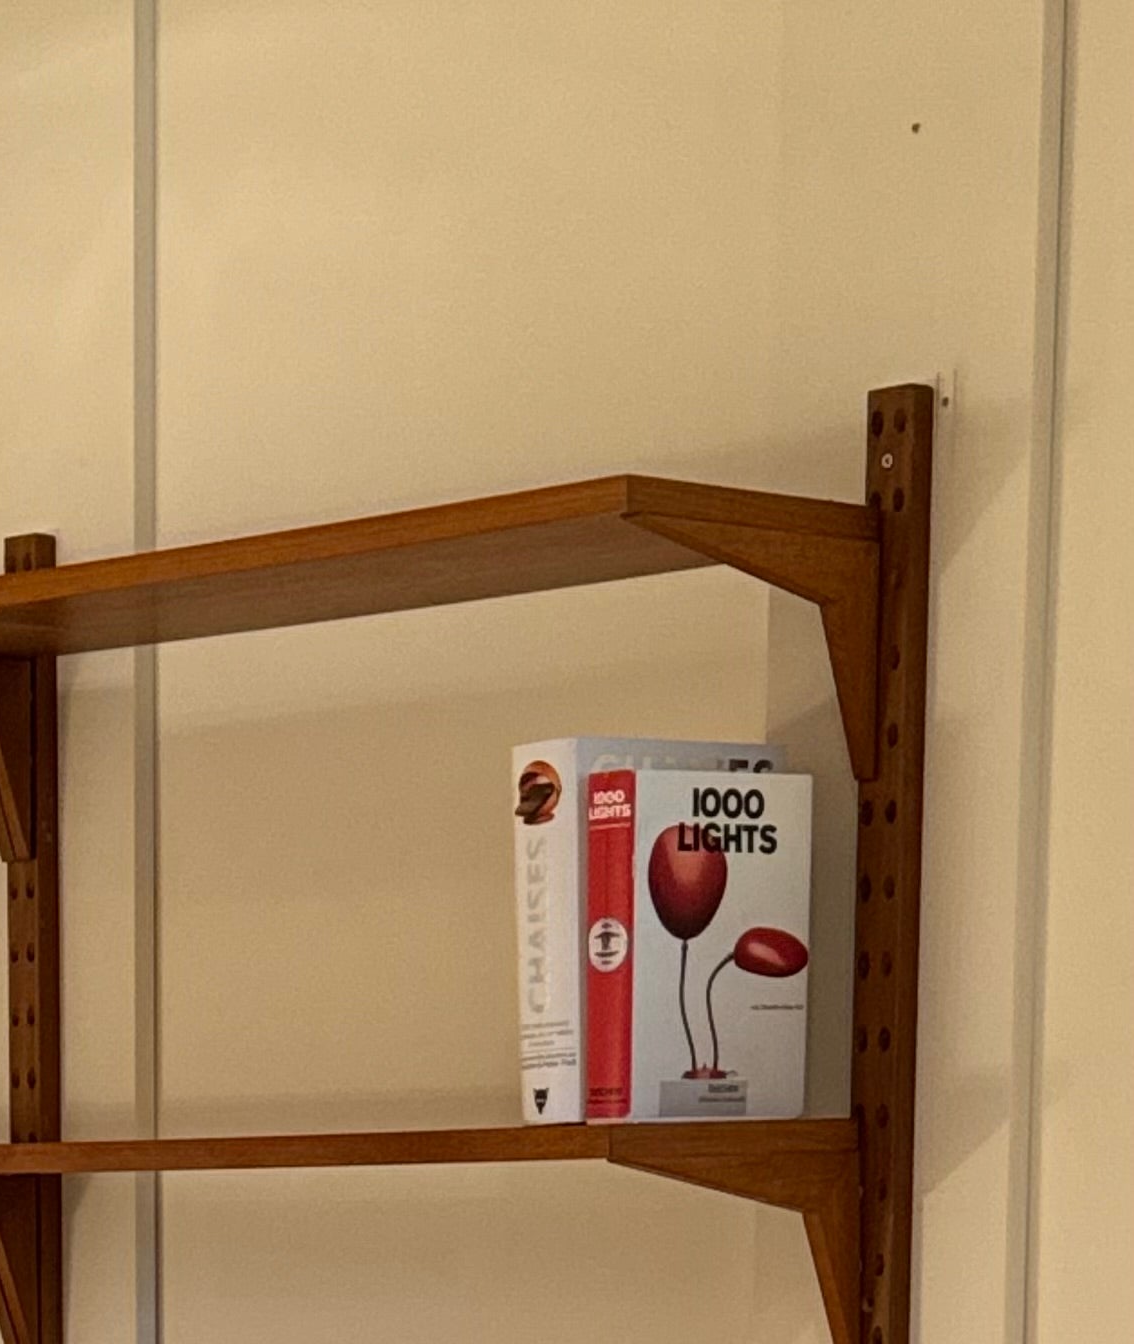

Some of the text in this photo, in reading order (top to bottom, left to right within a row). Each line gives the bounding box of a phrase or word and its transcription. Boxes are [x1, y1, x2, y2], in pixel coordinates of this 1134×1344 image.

[589, 804, 631, 820] LIGHTS
[594, 790, 626, 804] 1000
[693, 788, 765, 819] 1000
[677, 822, 777, 854] LIGHTS
[526, 836, 548, 1014] CHAISES
